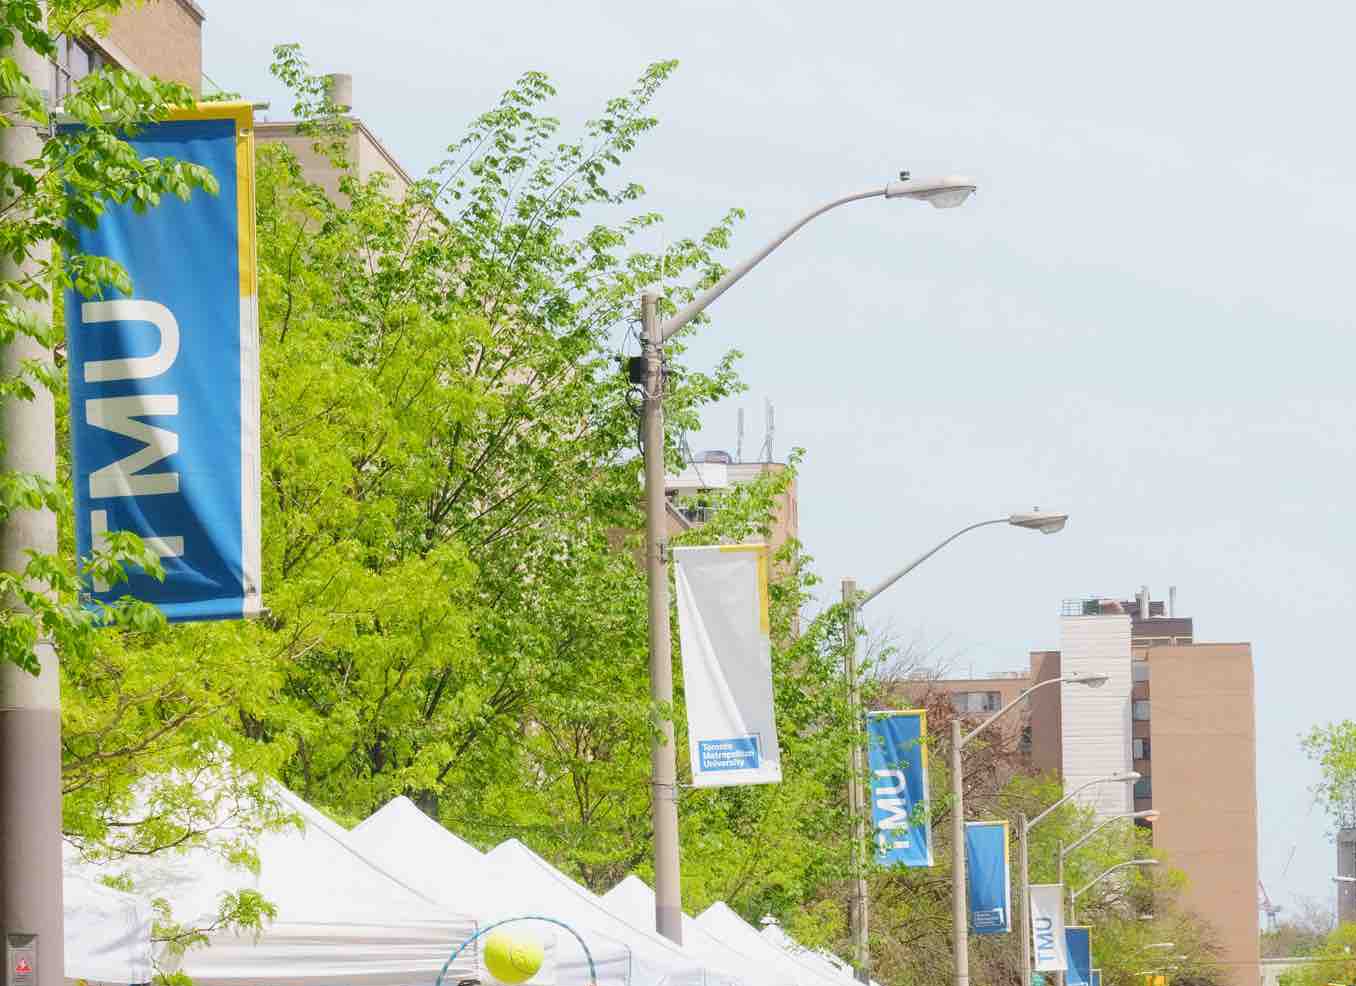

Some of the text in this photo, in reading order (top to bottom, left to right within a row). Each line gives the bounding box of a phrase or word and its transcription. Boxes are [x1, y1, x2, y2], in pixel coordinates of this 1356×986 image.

[81, 299, 184, 592] TMU
[703, 758, 745, 769] University
[874, 769, 911, 857] TMU
[1036, 917, 1057, 961] TMU
